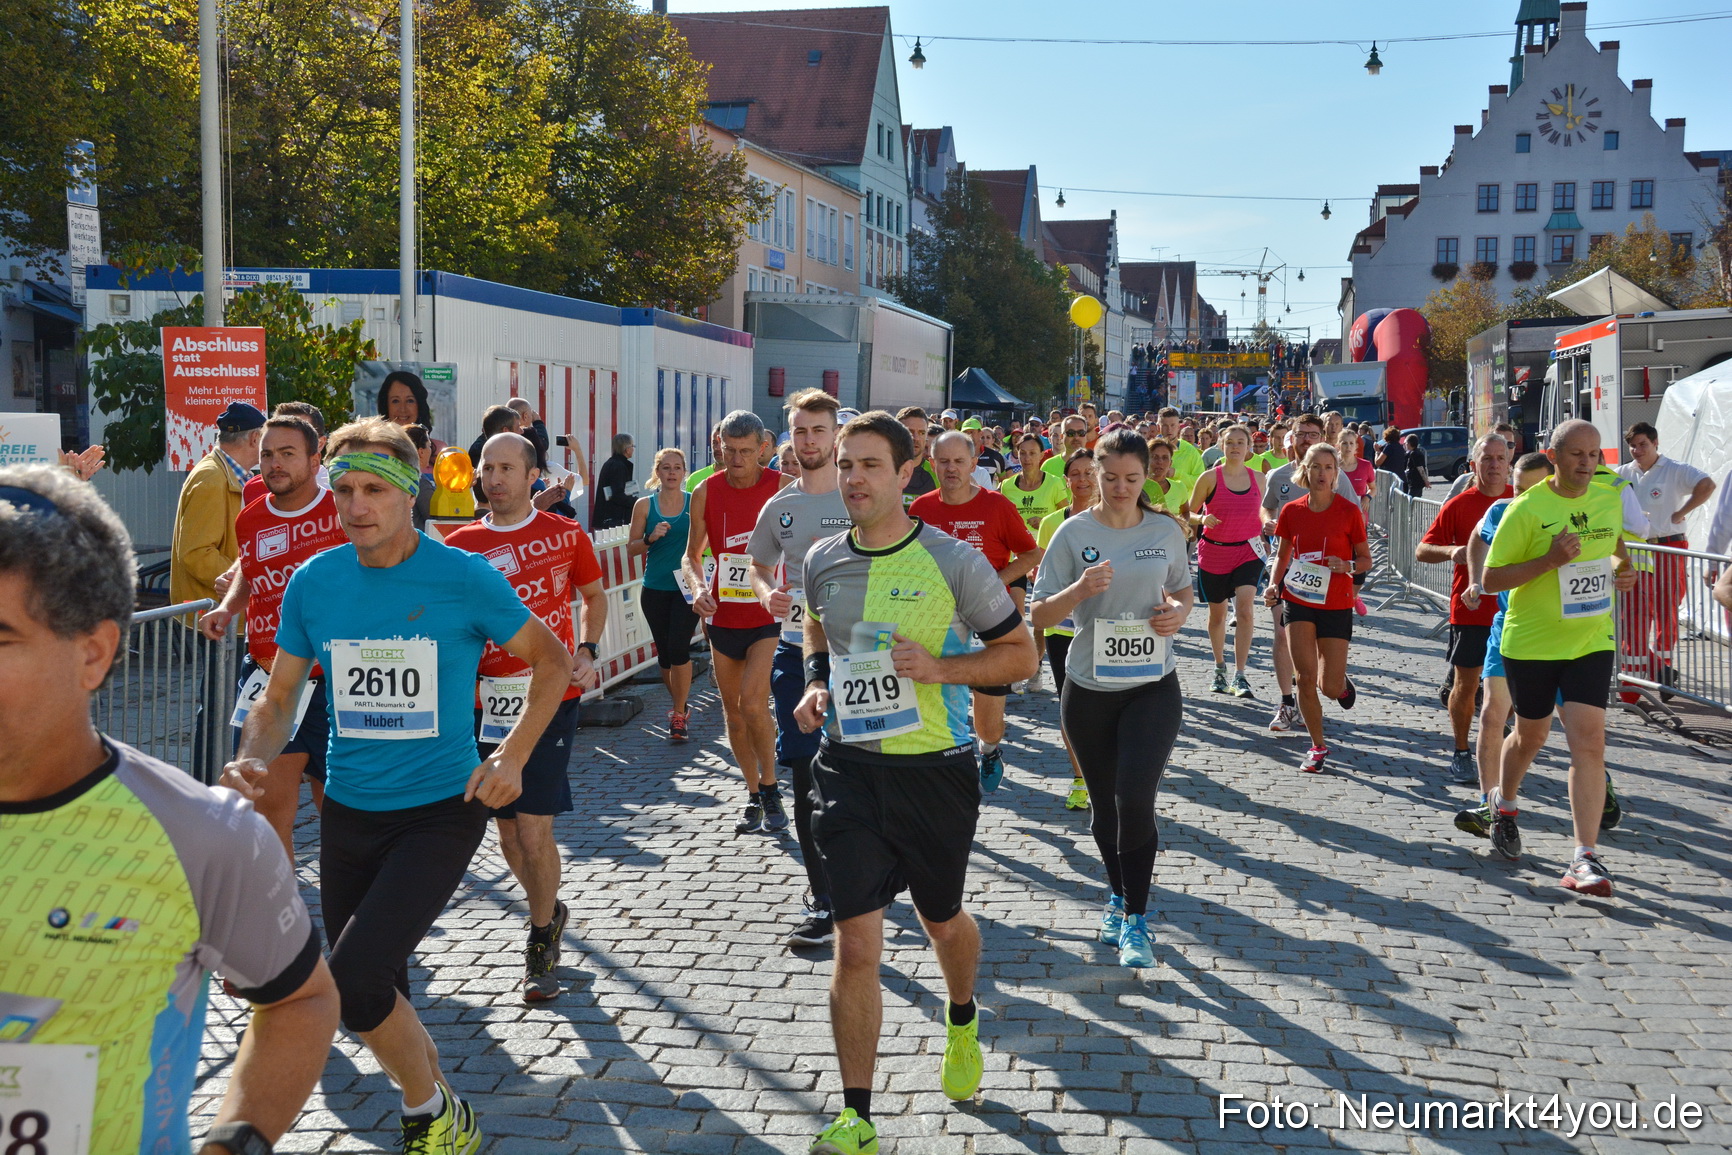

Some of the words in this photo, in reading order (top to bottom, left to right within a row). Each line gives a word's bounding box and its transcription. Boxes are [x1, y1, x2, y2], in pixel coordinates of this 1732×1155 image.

[74, 212, 84, 220] nur
[84, 213, 93, 221] mit
[71, 220, 98, 232] Parkschein
[73, 231, 97, 243] werktags
[172, 337, 259, 352] Abschluss
[172, 353, 201, 362] statt
[1202, 356, 1237, 365] START
[173, 363, 260, 377] Ausschluss!
[188, 386, 213, 395] Mehr
[215, 386, 243, 395] Lehrer
[244, 385, 257, 395] für
[185, 396, 221, 406] kleinere
[0, 444, 37, 454] REIE
[821, 518, 853, 526] BOCK
[258, 526, 288, 540] raumbox
[293, 534, 331, 551] schenken
[486, 546, 511, 560] umbox
[1134, 548, 1167, 558] BOCK
[525, 553, 562, 571] schenken
[729, 566, 749, 582] 27
[1291, 571, 1323, 588] 2435
[1569, 574, 1606, 595] 2297
[527, 597, 549, 610] tdoor
[1581, 602, 1602, 611] Robert
[1115, 625, 1144, 634] BOCK
[1105, 636, 1155, 657] 3050
[361, 648, 405, 659] BOCK
[850, 659, 881, 672] BOCK
[348, 667, 420, 698] 2610
[494, 683, 526, 692] BOCK
[843, 674, 901, 706] 2219
[488, 696, 526, 717] 222
[865, 705, 892, 714] Neumarkt
[364, 714, 404, 728] Hubert
[865, 717, 886, 731] Ralf
